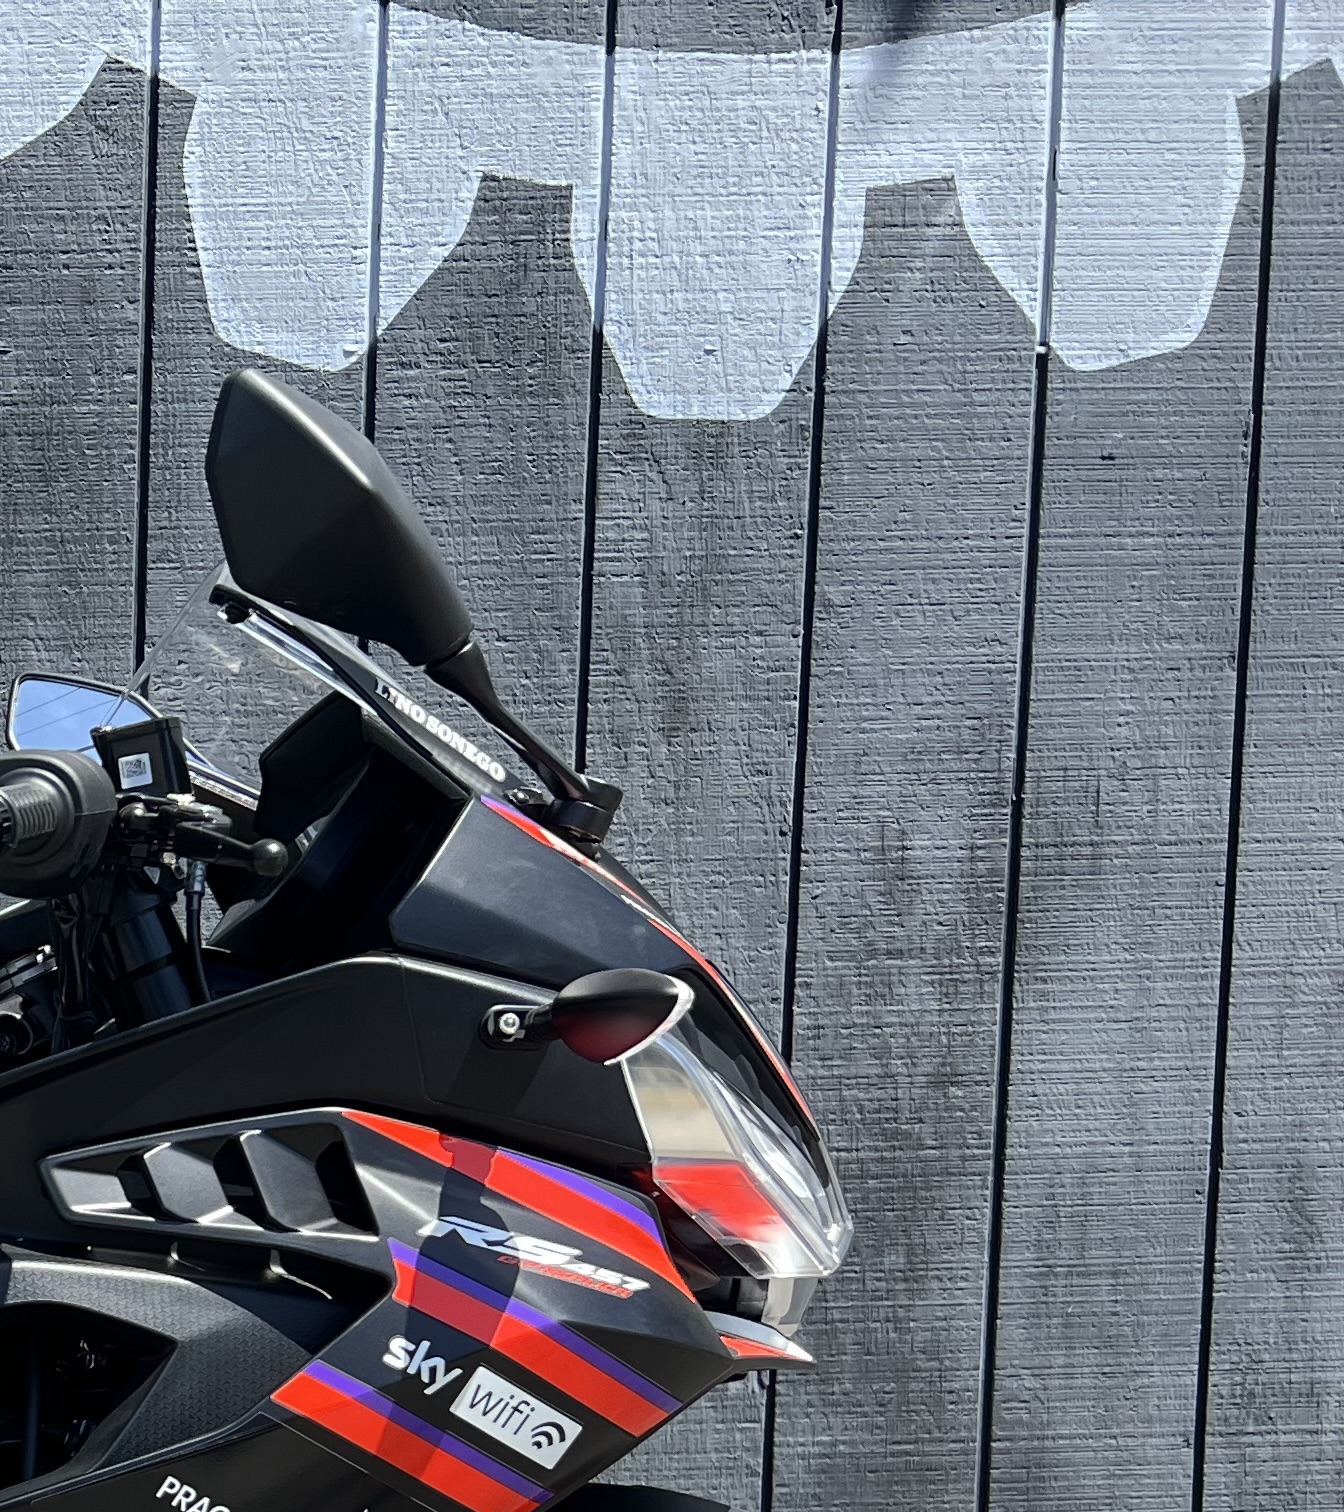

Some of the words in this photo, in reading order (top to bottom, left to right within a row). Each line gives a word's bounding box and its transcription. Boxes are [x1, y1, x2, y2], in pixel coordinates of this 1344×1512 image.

[426, 715, 506, 783] SONEGO
[381, 1333, 464, 1396] sky
[469, 1382, 537, 1434] wifi
